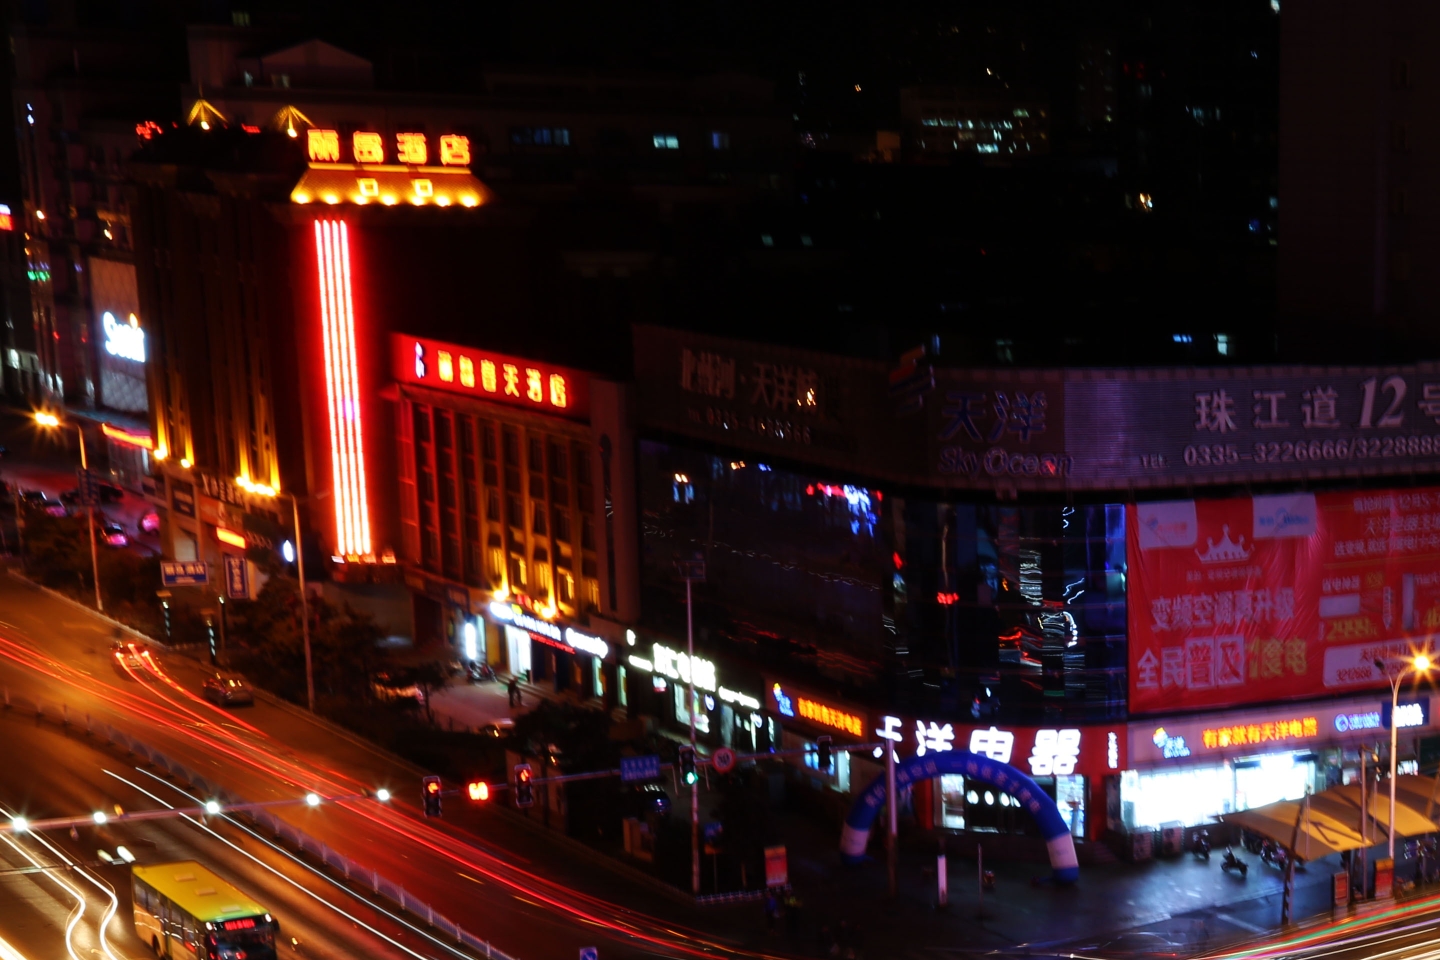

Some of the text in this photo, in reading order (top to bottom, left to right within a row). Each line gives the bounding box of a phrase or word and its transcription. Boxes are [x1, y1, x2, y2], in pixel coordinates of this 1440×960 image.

[938, 390, 1048, 444] 天洋
[937, 446, 1074, 479] SkyOcean
[875, 715, 1081, 776] 天洋电器
